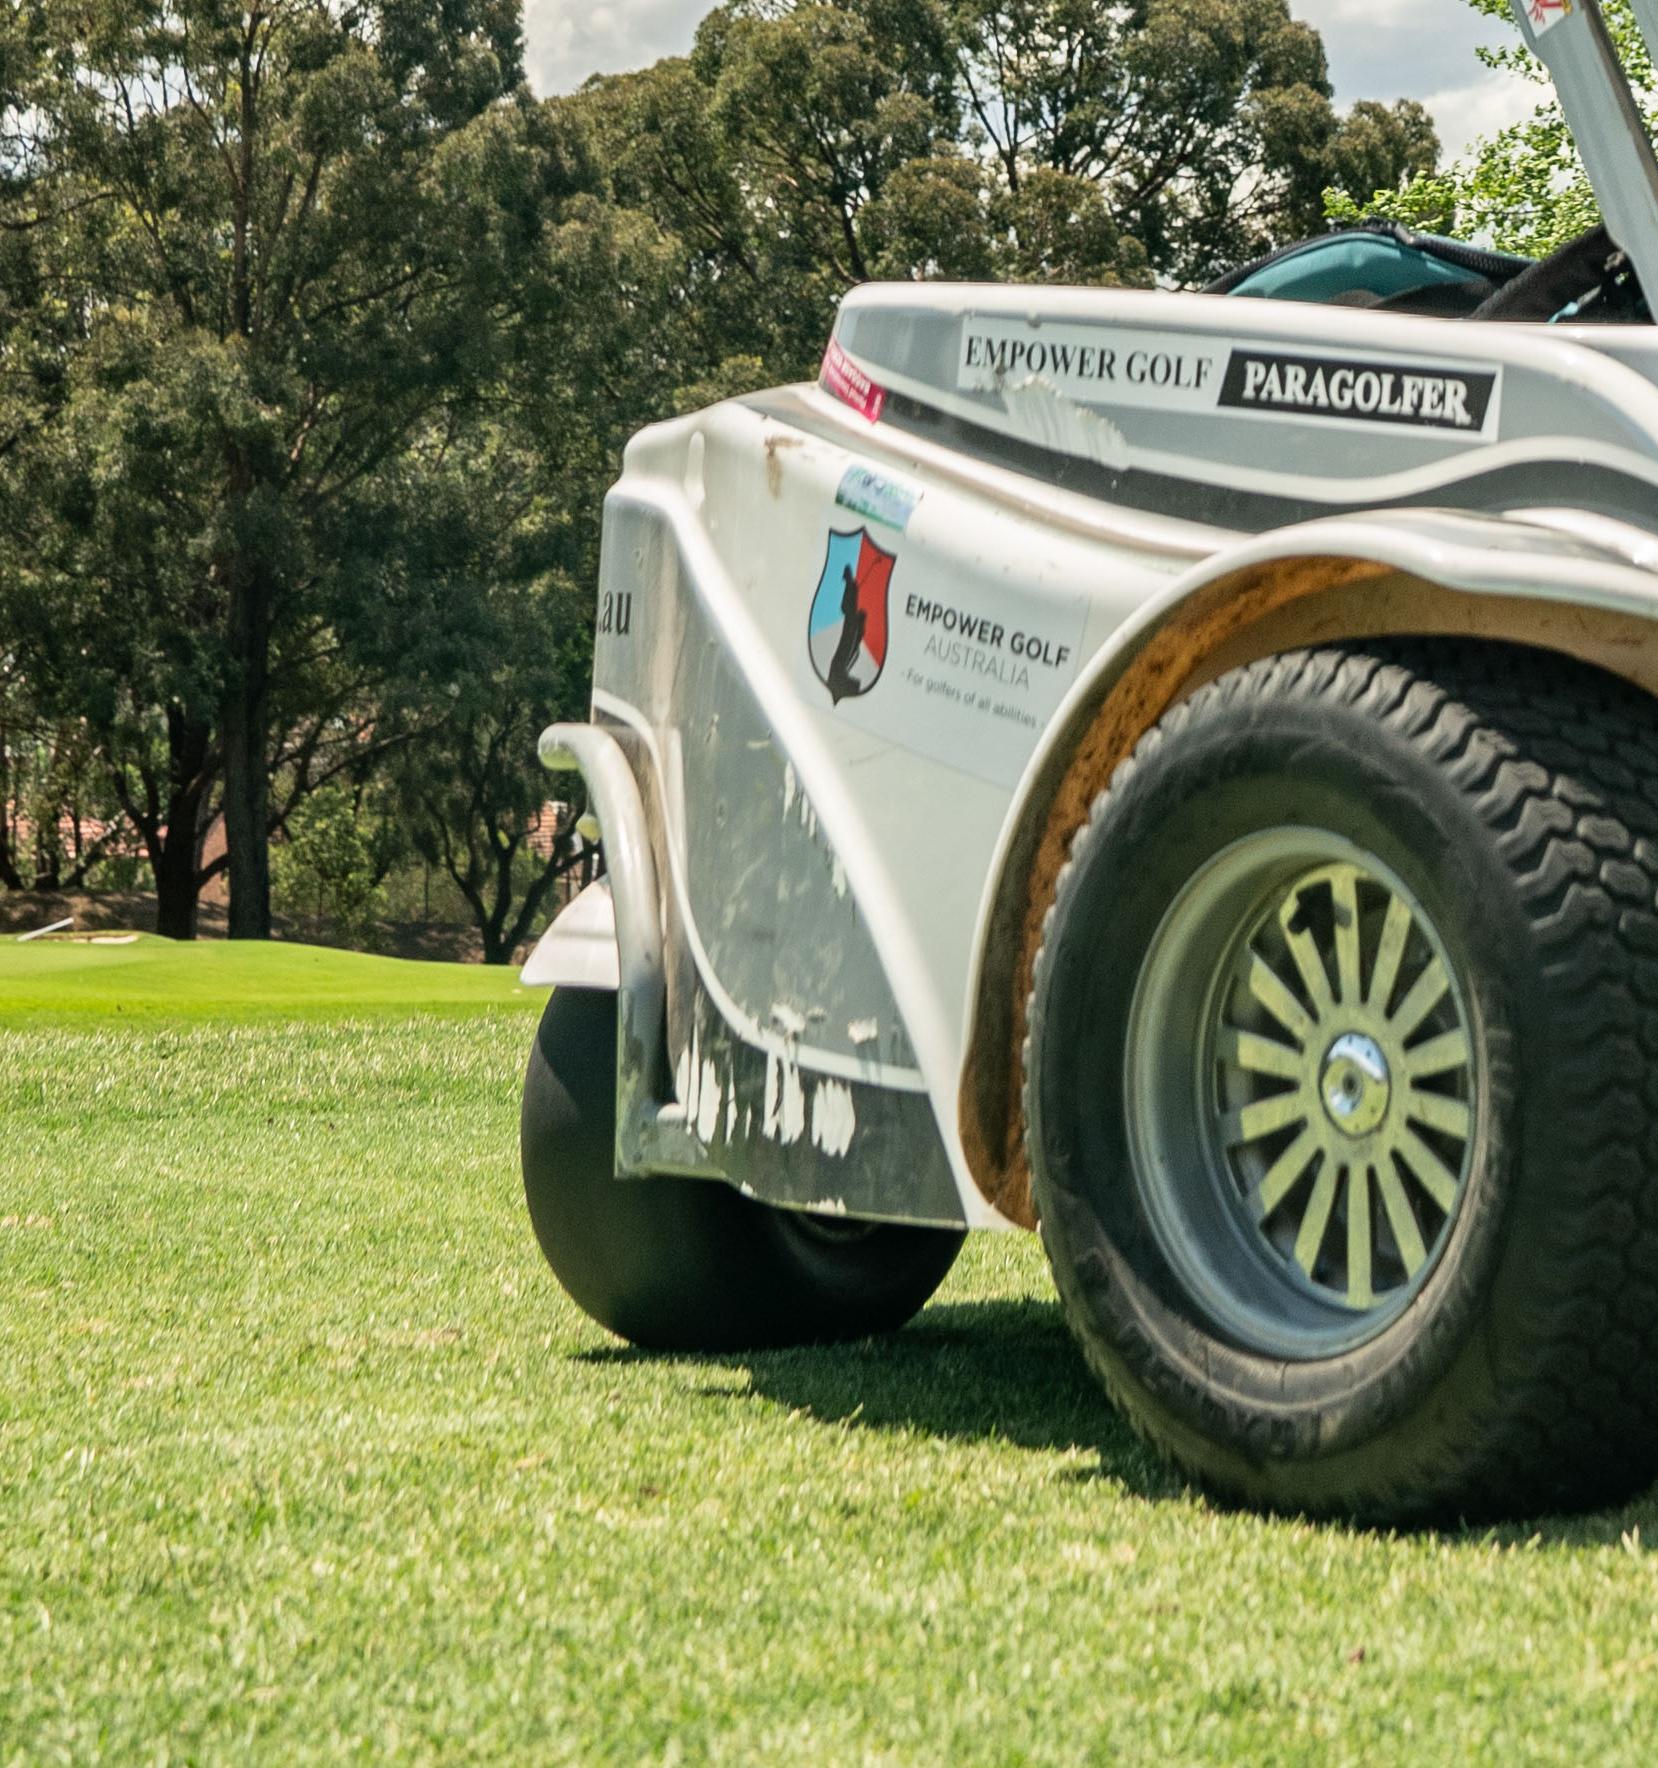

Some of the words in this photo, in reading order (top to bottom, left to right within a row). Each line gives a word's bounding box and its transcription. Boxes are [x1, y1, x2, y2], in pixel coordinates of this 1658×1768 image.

[965, 335, 1117, 382] EMPOWER
[1126, 350, 1213, 389] GOLF
[1241, 360, 1472, 426] PARAGOLFER
[905, 594, 1005, 648] EMPOWER
[1010, 631, 1071, 668] GOLF
[923, 633, 1030, 691] AUSTRALIA
[963, 690, 977, 705] of
